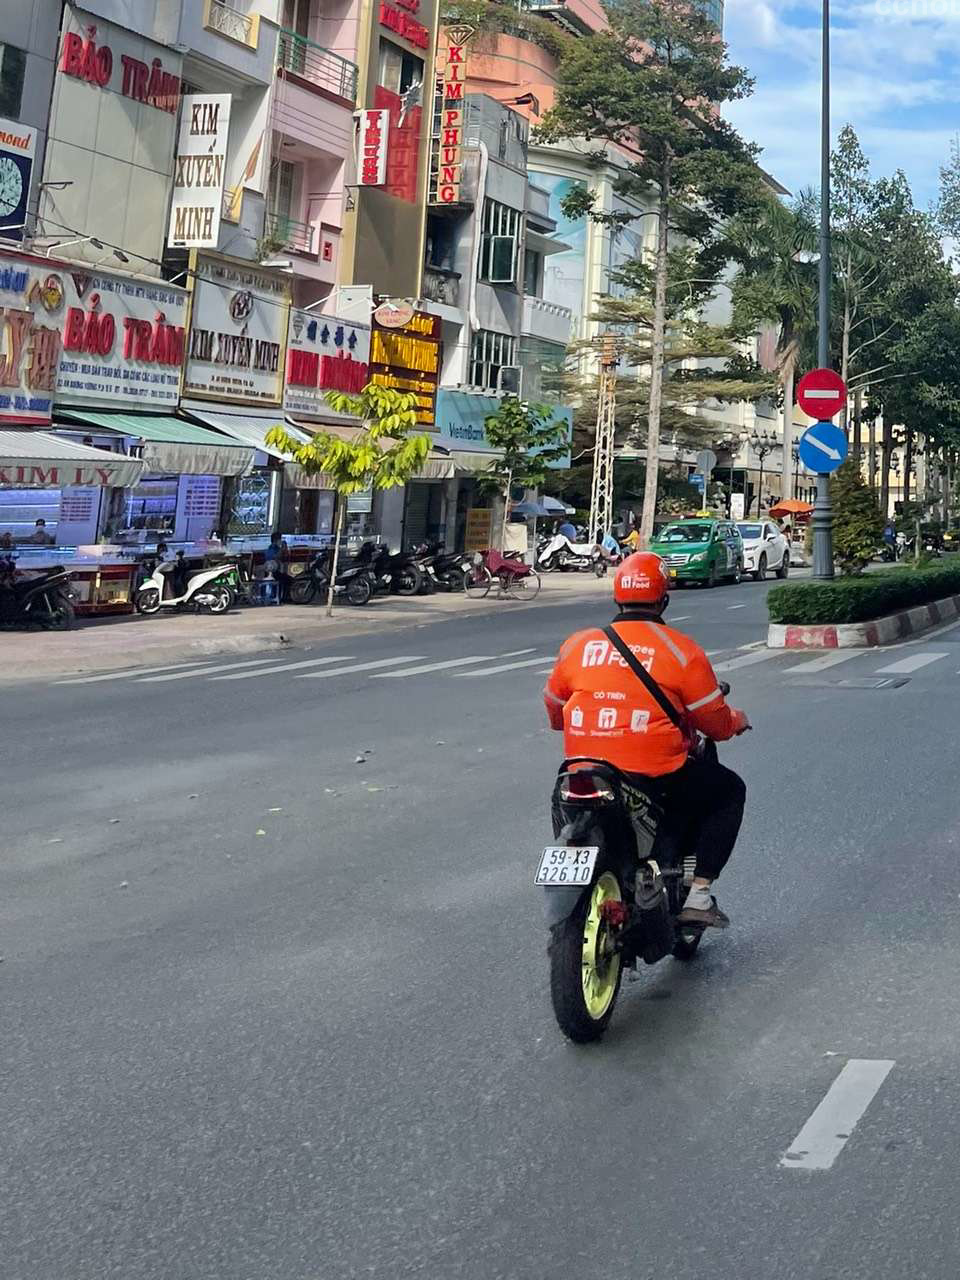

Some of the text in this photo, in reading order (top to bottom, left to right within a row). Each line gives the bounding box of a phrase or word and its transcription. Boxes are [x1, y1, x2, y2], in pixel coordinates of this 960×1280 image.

[190, 103, 220, 136] KIM
[442, 47, 463, 203] KIM PHUNG
[173, 207, 214, 240] MINH
[64, 293, 115, 357] BẢO
[607, 652, 654, 674] Fod
[550, 850, 590, 865] 59-X3
